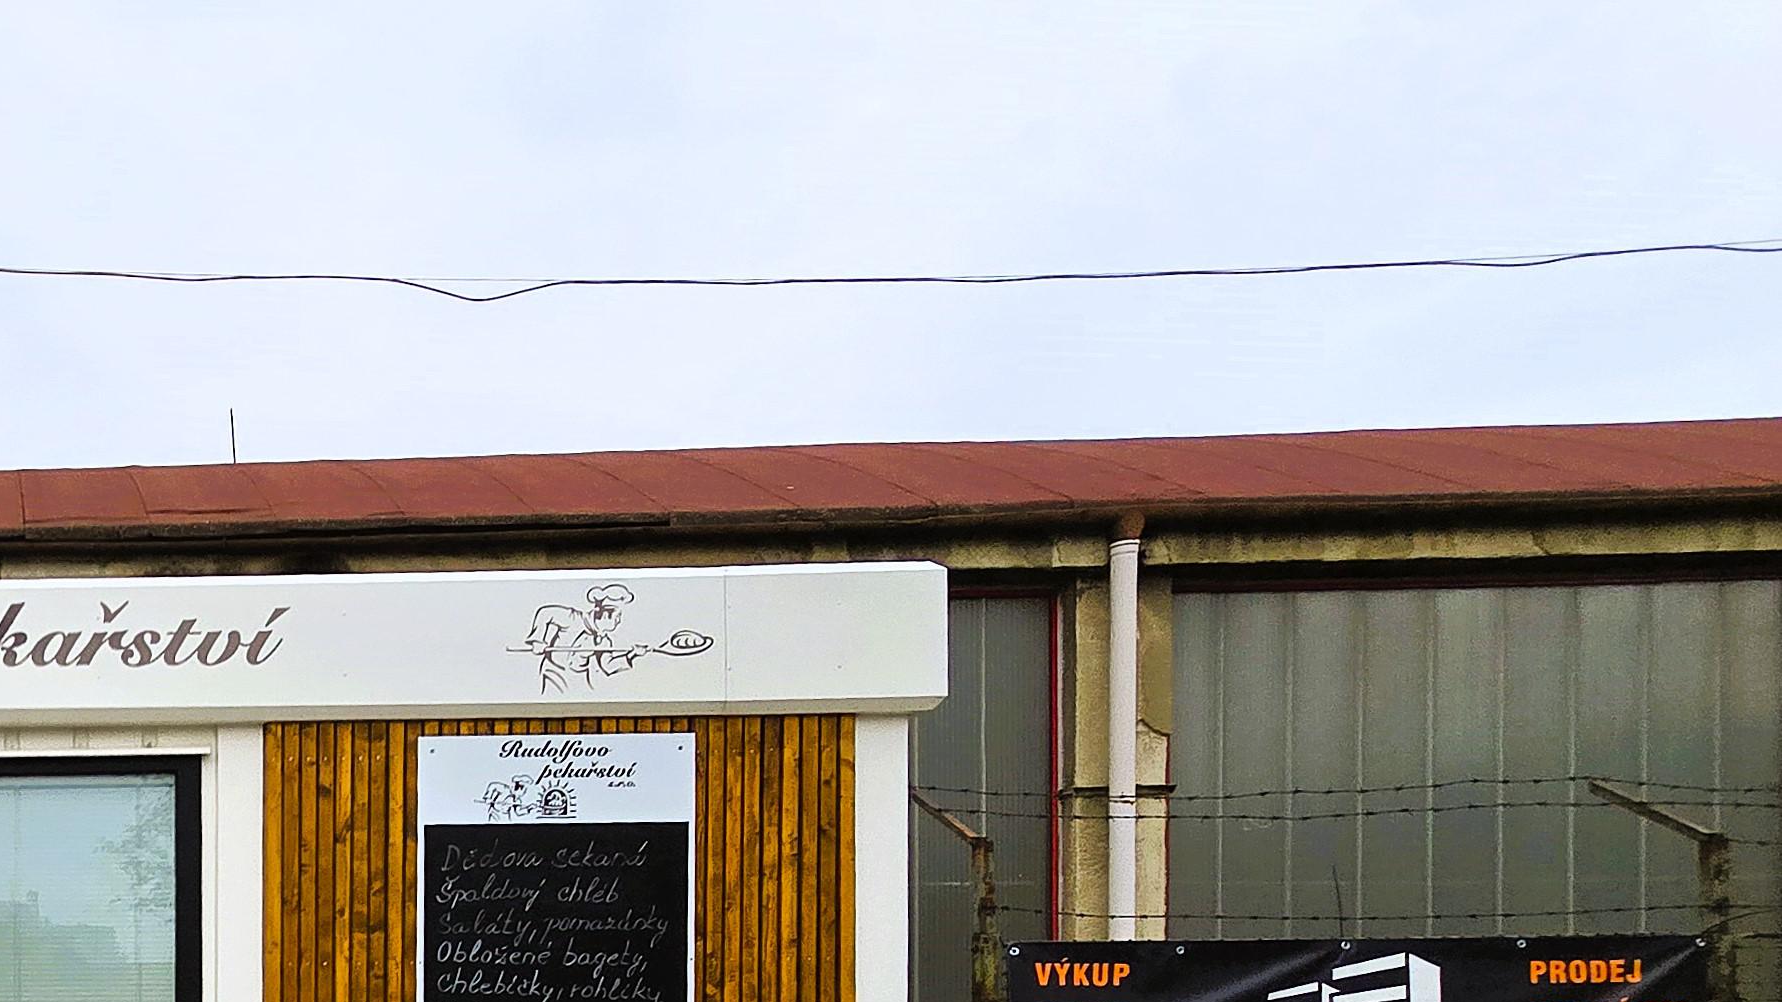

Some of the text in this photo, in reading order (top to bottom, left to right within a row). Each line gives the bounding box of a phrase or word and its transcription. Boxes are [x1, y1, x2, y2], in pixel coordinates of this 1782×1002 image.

[499, 740, 612, 763] Rudolfovo
[535, 761, 637, 785] pekařství
[552, 841, 648, 868] sekaná
[436, 873, 618, 911] Špaldový chléb
[540, 905, 668, 948] pomazánky
[437, 937, 647, 978] Obložené bagety,
[1035, 958, 1130, 986] VÝKUP
[1530, 959, 1642, 984] PRODEJ
